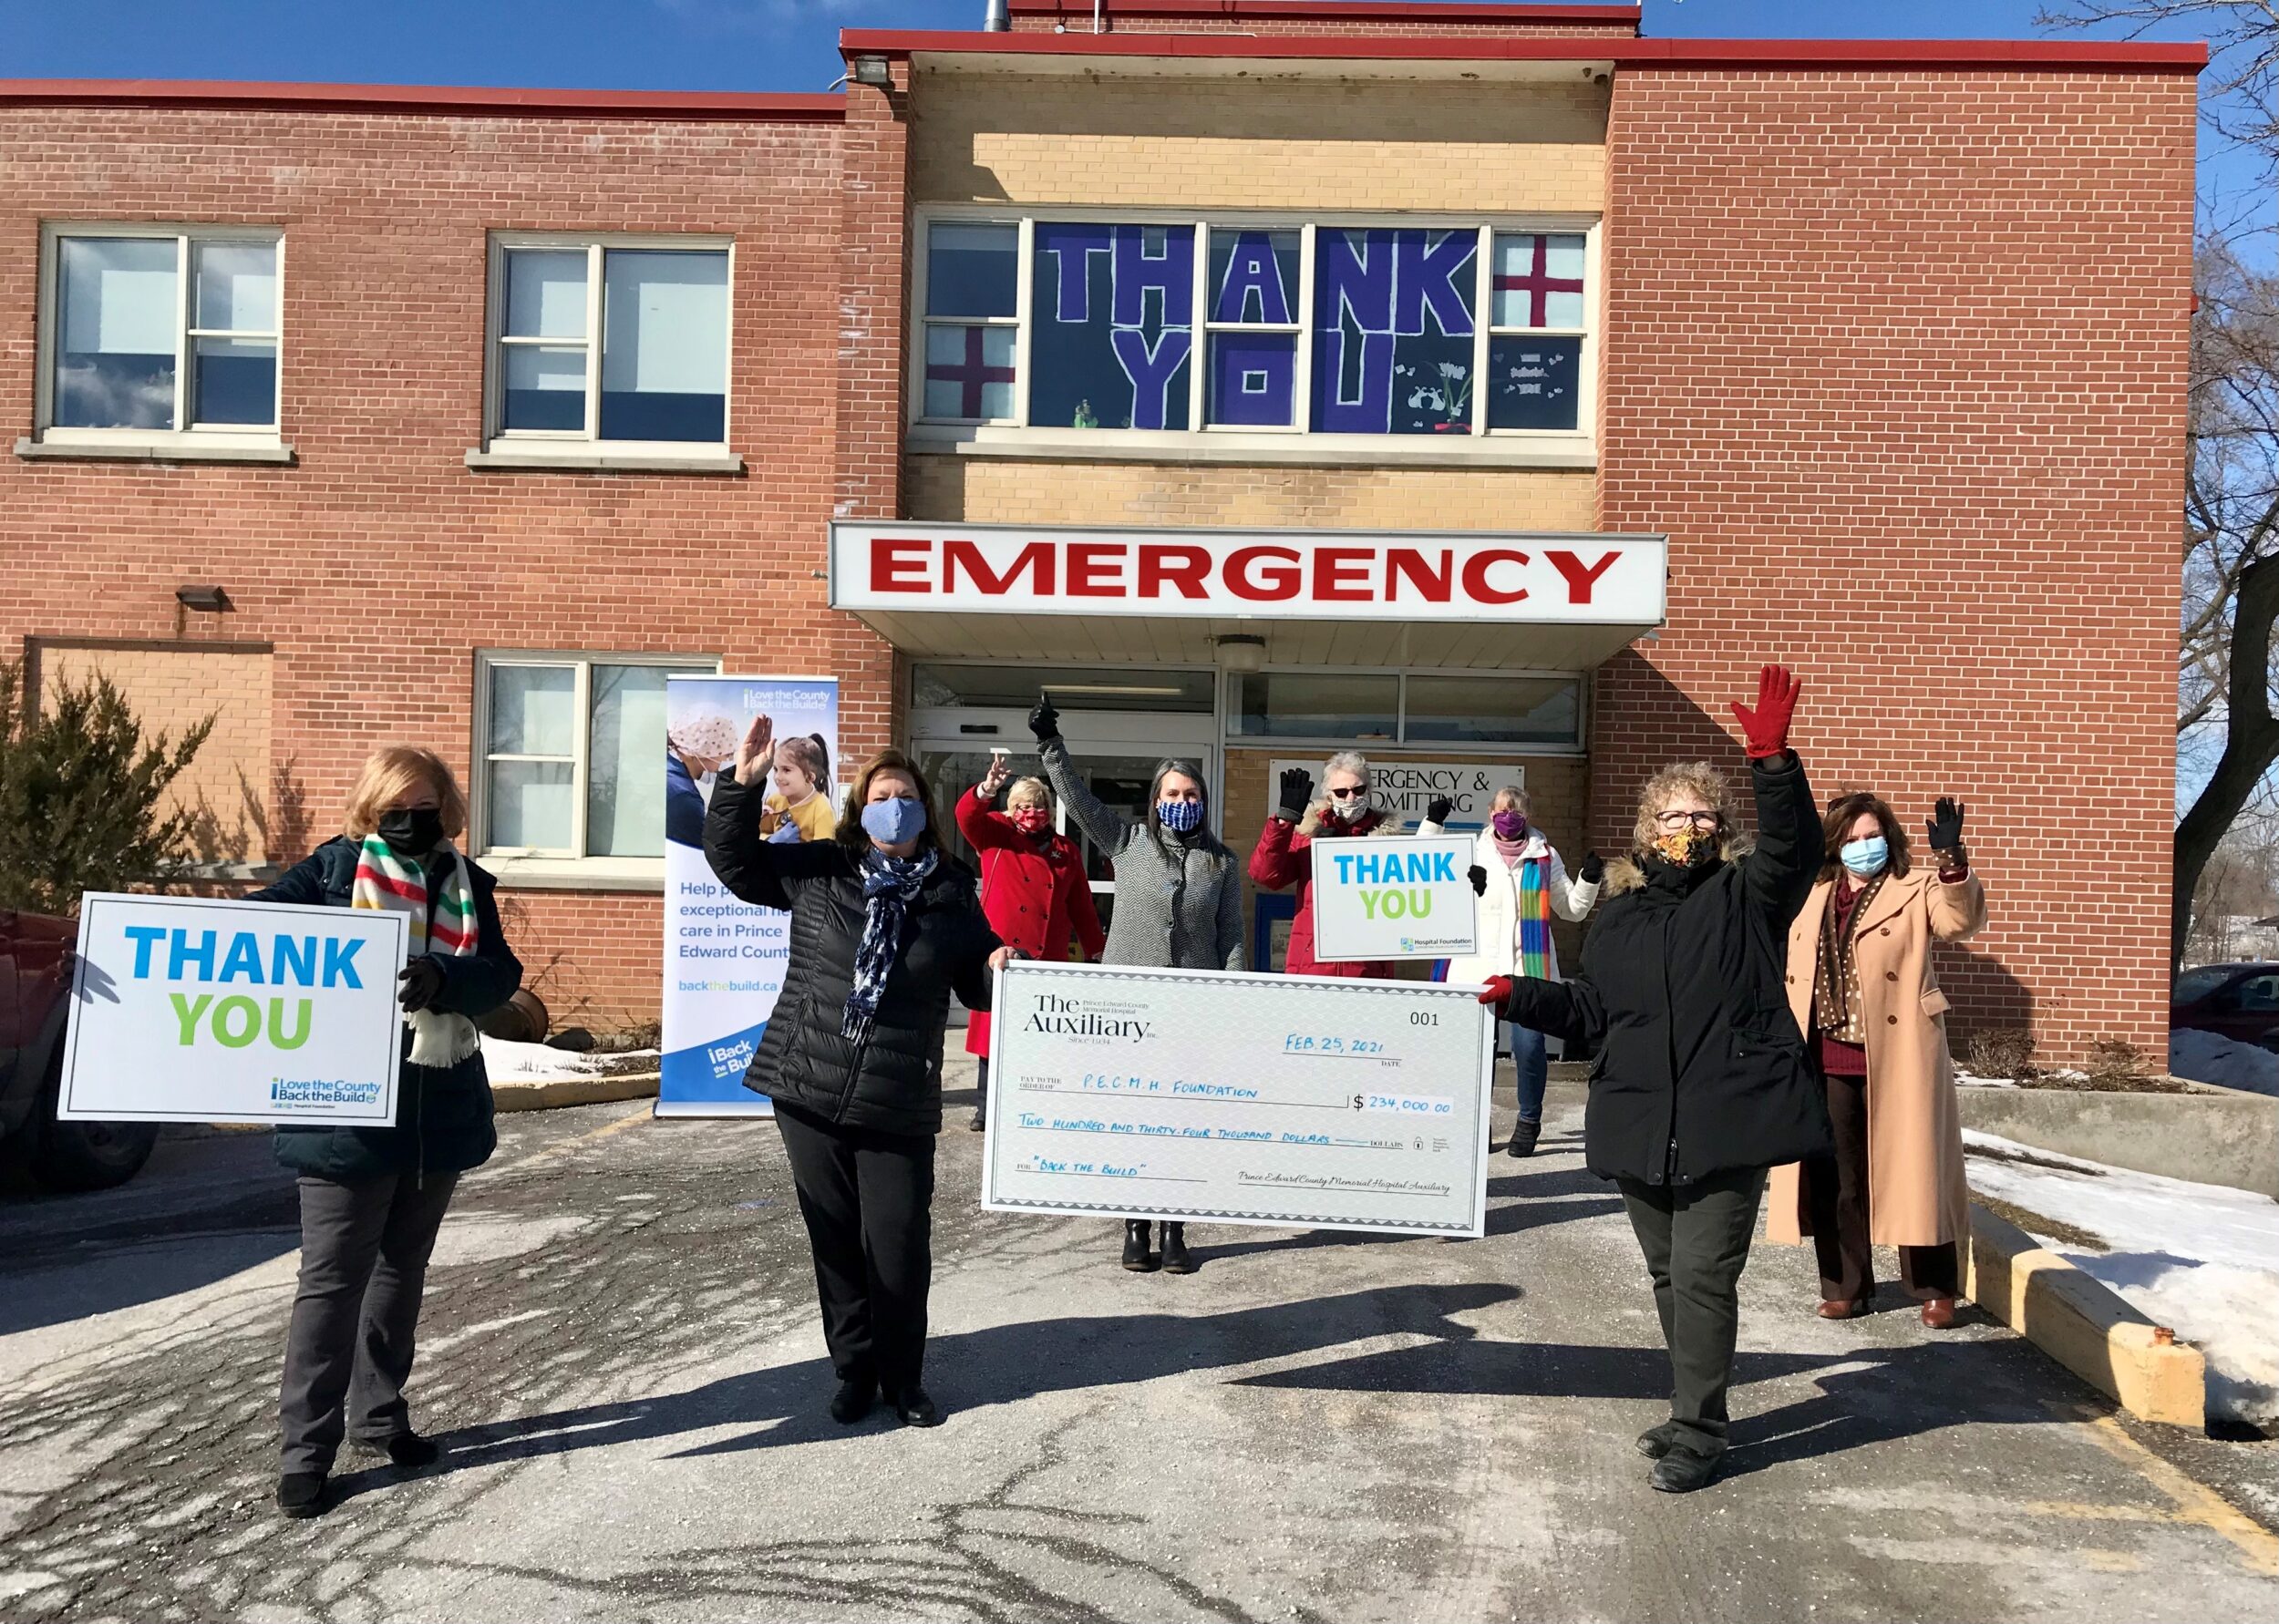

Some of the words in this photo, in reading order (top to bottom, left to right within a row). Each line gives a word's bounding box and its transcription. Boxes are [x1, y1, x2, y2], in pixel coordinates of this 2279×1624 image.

[1036, 225, 1480, 337] THANK
[1109, 328, 1395, 433] YOU
[870, 538, 1623, 605] EMERGENCY
[749, 689, 774, 699] Love
[775, 689, 792, 699] the
[792, 690, 830, 701] County
[749, 699, 774, 709] Back
[775, 699, 792, 709] the
[792, 699, 818, 709] Build
[1369, 769, 1463, 790] ERGENCY
[1473, 771, 1490, 791] &
[1369, 791, 1473, 813] DMITTNG
[1334, 851, 1456, 885] THANK
[680, 882, 717, 898] Help
[680, 903, 768, 919] exceptional
[1358, 889, 1432, 920] YOU
[679, 926, 713, 937] care
[717, 924, 730, 937] in
[735, 924, 783, 938] Prince
[124, 925, 367, 990] THANK
[679, 945, 737, 958] Edward
[742, 945, 790, 958] Count
[678, 980, 778, 992] backthebuild.ca
[1034, 994, 1080, 1013] The
[1128, 1002, 1150, 1010] County
[1110, 1007, 1136, 1015] Hospital
[168, 992, 313, 1051] YOU
[1024, 1012, 1150, 1043] Auxiliary
[1409, 1012, 1439, 1026] 001
[715, 1040, 753, 1063] Back
[1321, 1037, 1345, 1054] 25,
[1351, 1040, 1384, 1053] 2021
[714, 1064, 727, 1074] the
[727, 1052, 754, 1073] Buil
[1381, 1060, 1401, 1068] DATE
[280, 1078, 311, 1090] Love
[312, 1079, 334, 1091] the
[334, 1080, 382, 1095] County
[1173, 1080, 1258, 1098] FOUNDATION
[279, 1089, 311, 1102] Back
[312, 1090, 333, 1103] the
[334, 1092, 365, 1103] Build
[1052, 1118, 1106, 1131] HUNDRED
[1110, 1123, 1134, 1134] AND
[1218, 1128, 1273, 1140] THOUSAND
[1282, 1132, 1330, 1145] DOLLARS
[1074, 1163, 1094, 1173] THE
[1238, 1171, 1263, 1182] Prince
[1264, 1171, 1299, 1183] Edward
[1299, 1174, 1327, 1187] County
[1326, 1176, 1372, 1187] Memorial
[1371, 1177, 1408, 1192] Hospital
[1408, 1181, 1450, 1195] Auxiliary
